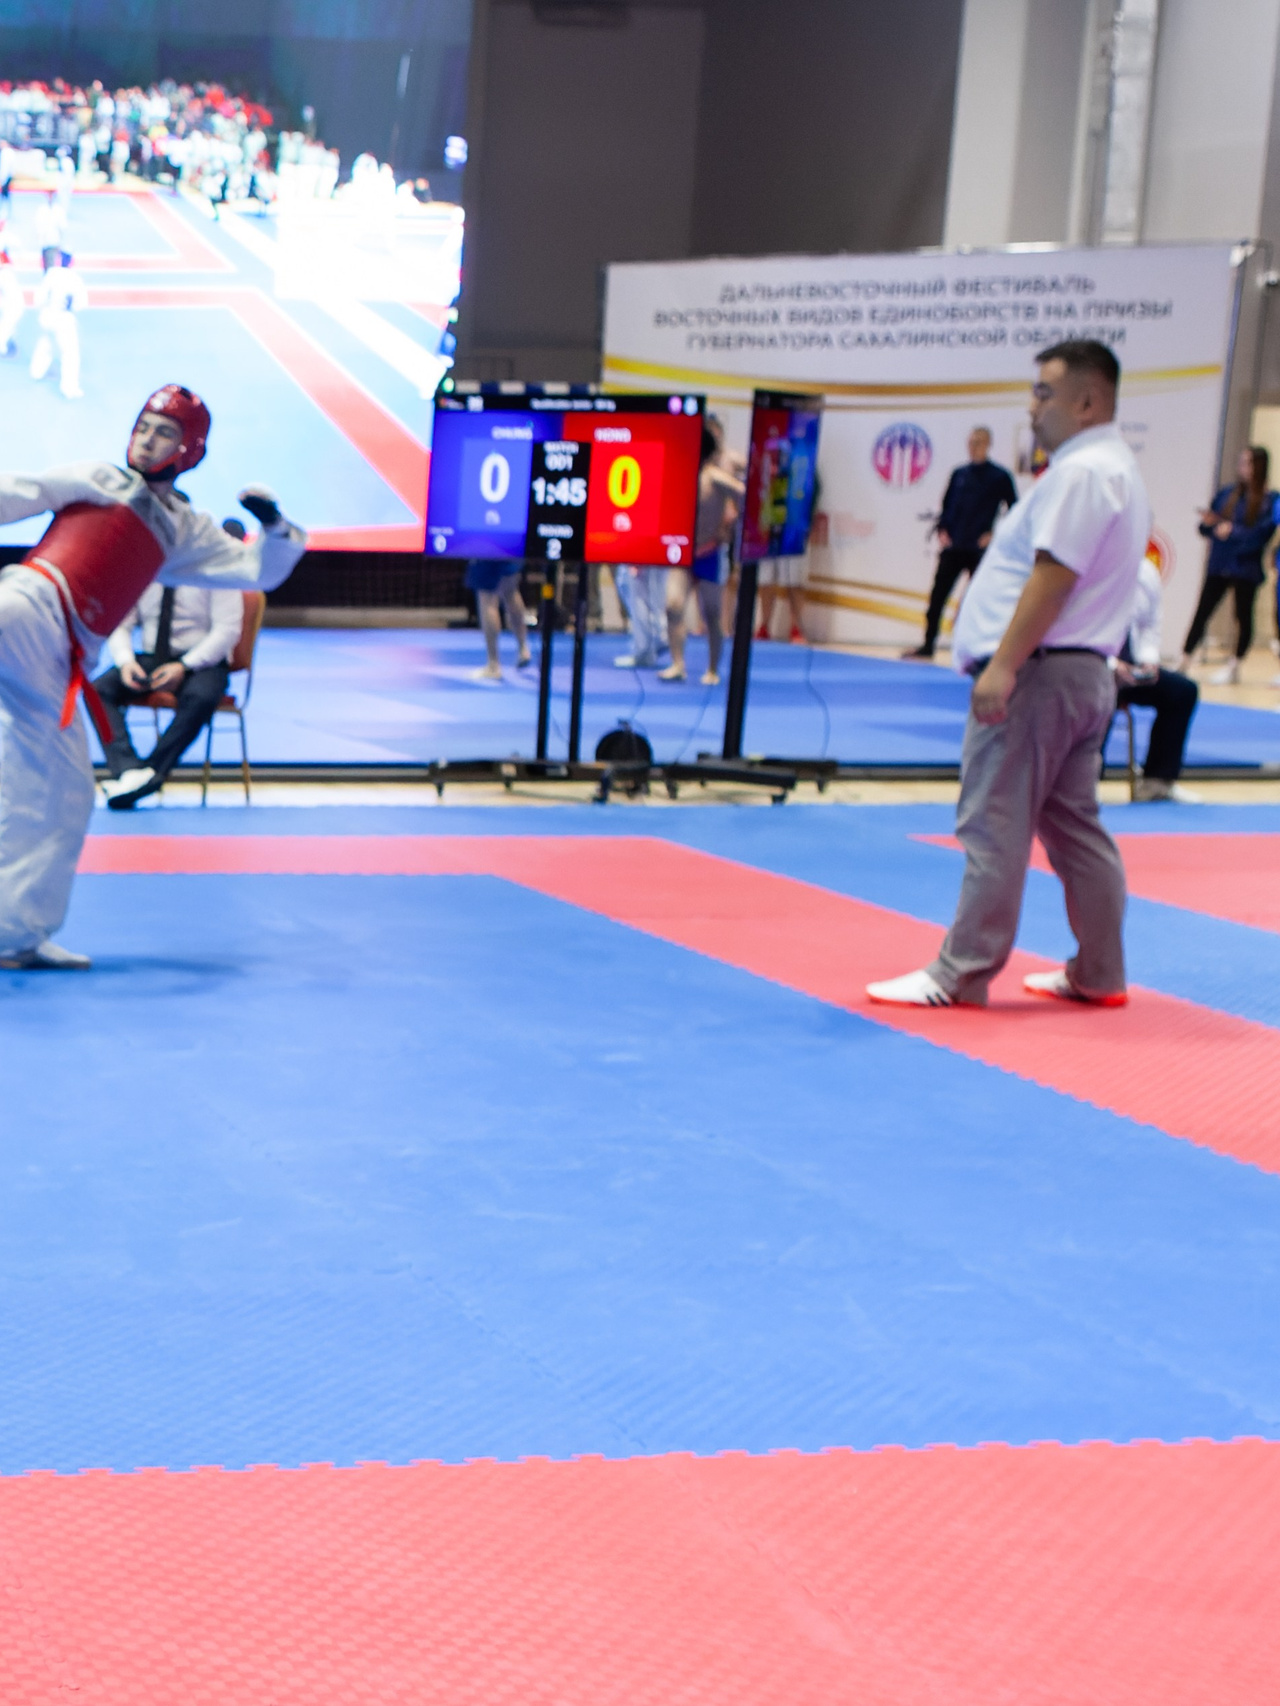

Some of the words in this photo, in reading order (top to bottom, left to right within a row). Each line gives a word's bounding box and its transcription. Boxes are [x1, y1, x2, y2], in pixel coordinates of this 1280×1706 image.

[720, 276, 947, 304] ДАЛЬНЕВОСТОЧНЫЙ
[952, 272, 1096, 296] ФЕСТИВАЛЬ
[653, 307, 781, 328] ВОСТОЧНЫХ
[788, 305, 863, 326] ВИДОВ
[870, 301, 1039, 325] ЕДИНОБОРСТВ
[1043, 301, 1078, 320] НА
[1083, 299, 1173, 320] ПРИЗЫ
[686, 330, 834, 351] ГУБЕРНАТОРА
[838, 325, 1007, 350] САХАЛИНСКОЙ
[545, 453, 573, 471] 001
[480, 453, 510, 503] 0
[532, 477, 587, 507] 1:45
[608, 455, 641, 508] 0
[546, 538, 562, 560] 2
